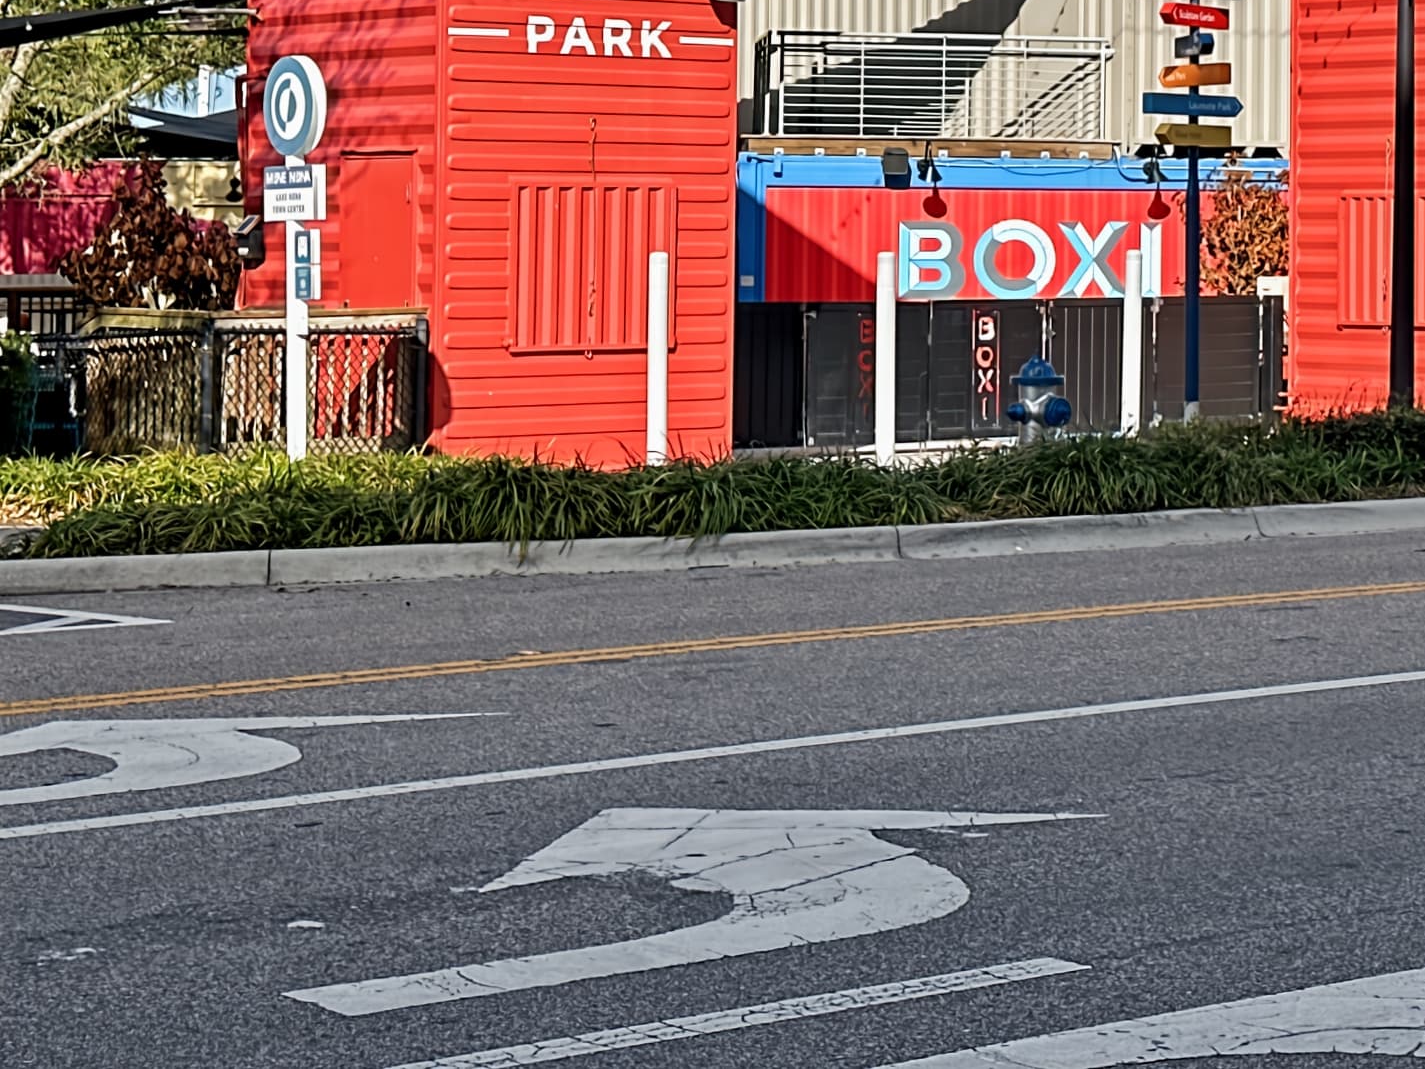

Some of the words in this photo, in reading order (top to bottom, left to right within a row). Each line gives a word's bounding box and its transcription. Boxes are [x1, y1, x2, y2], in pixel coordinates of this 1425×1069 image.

[526, 15, 673, 59] PARK
[898, 219, 1163, 300] BOXI
[976, 316, 995, 420] BOXI
